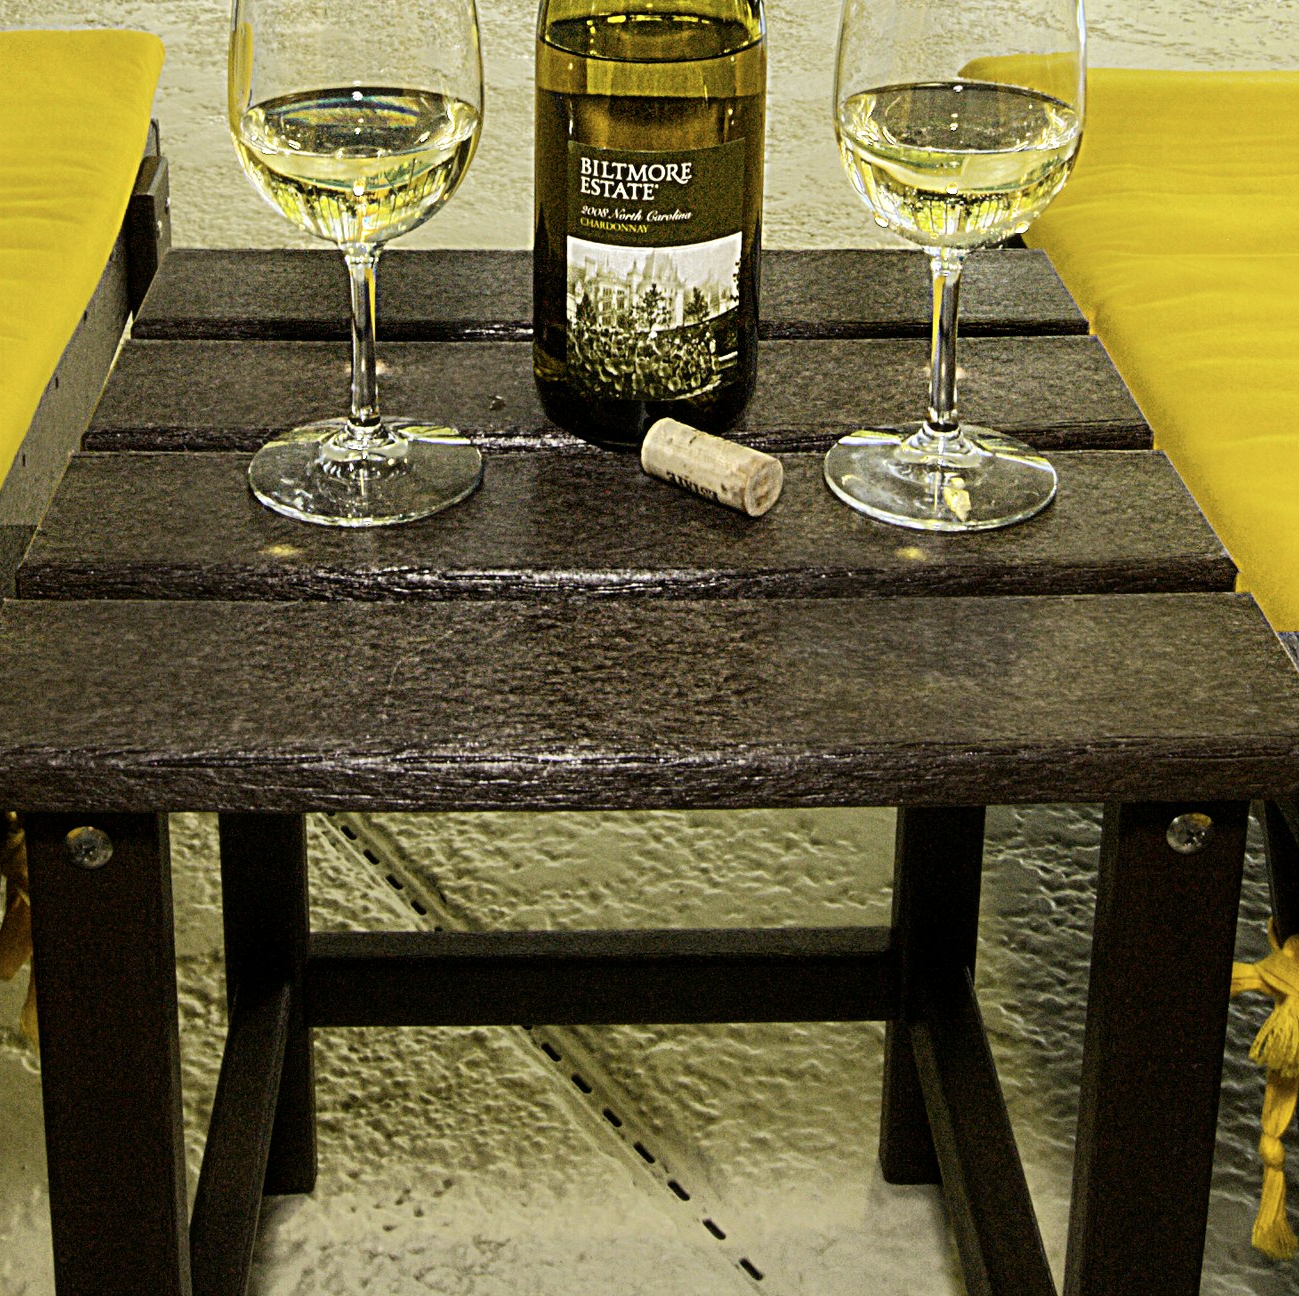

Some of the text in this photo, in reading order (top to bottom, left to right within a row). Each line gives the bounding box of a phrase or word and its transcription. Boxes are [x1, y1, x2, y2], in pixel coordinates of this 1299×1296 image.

[580, 157, 692, 185] BILTMORE
[580, 176, 655, 201] ESTATE
[581, 205, 692, 222] 2008 North Carolina
[580, 217, 649, 234] CHARDONNAY
